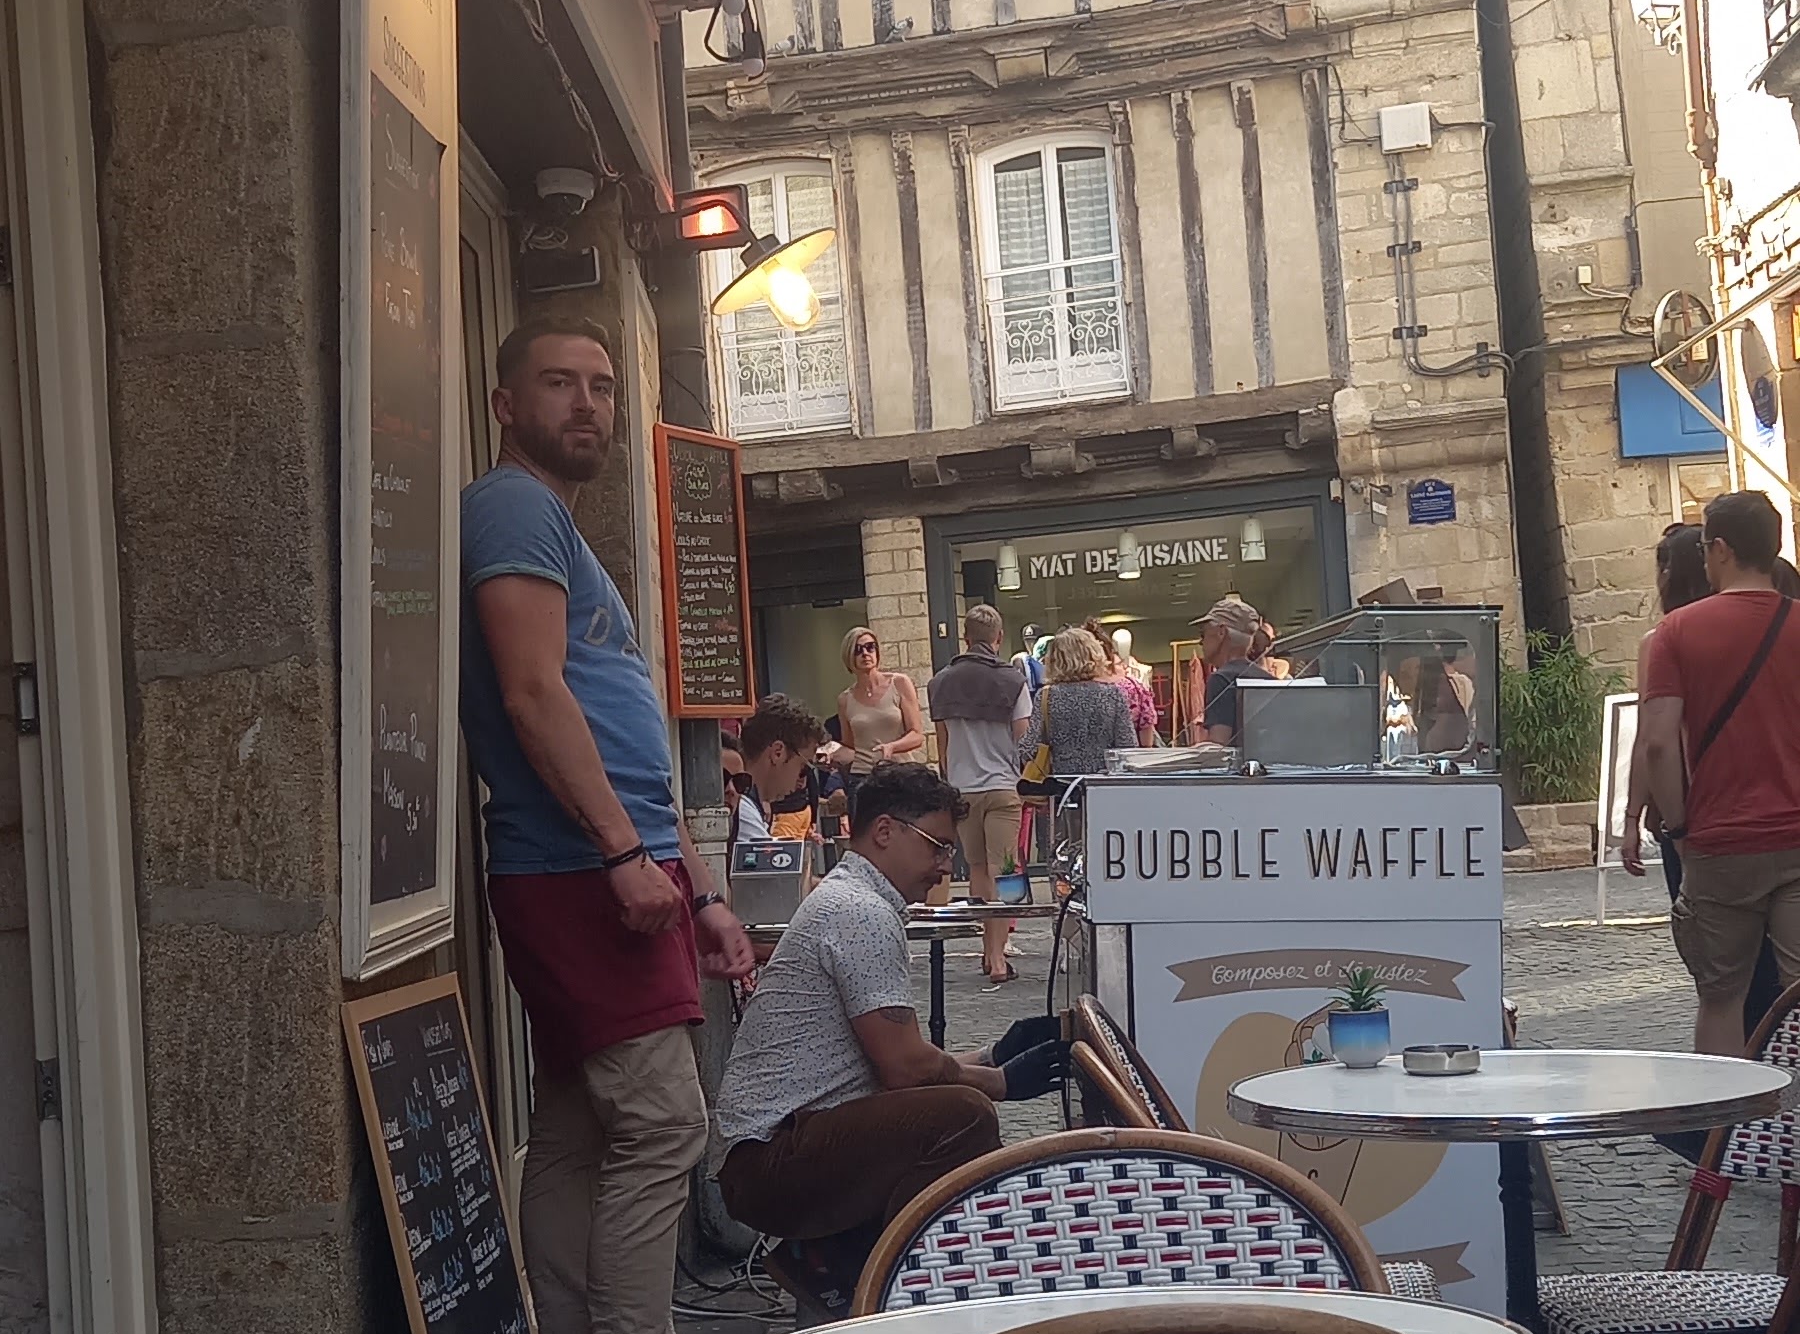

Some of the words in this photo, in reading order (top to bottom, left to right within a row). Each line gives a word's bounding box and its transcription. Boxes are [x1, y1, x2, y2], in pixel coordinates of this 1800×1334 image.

[1030, 553, 1077, 579] MAT
[1085, 548, 1119, 574] DE
[1103, 828, 1281, 882] BUBBLE
[1304, 826, 1485, 880] WAFFLE
[1211, 964, 1310, 988] Composez
[1314, 959, 1333, 978] et
[1338, 959, 1432, 986] déustez
